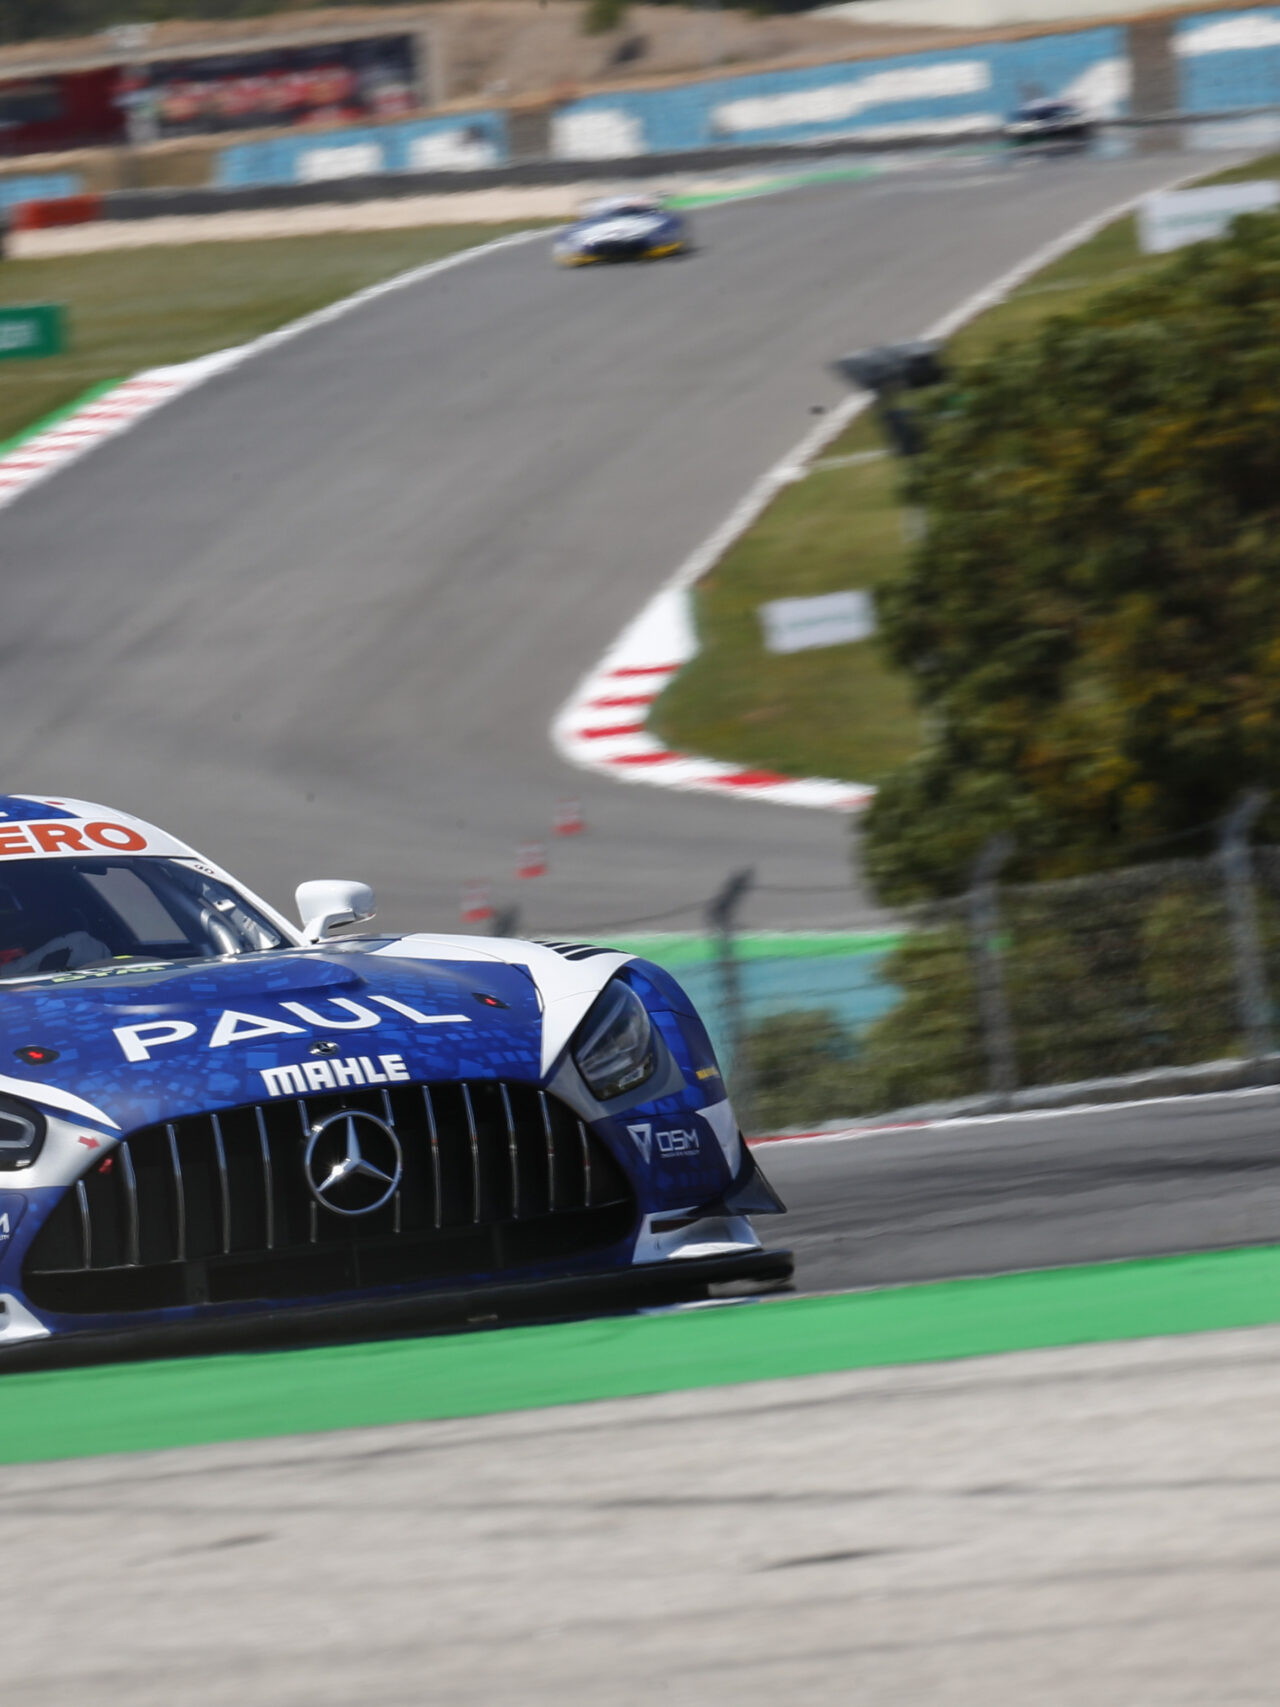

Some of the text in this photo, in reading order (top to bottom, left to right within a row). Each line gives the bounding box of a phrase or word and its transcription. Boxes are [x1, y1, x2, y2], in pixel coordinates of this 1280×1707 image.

[112, 995, 472, 1062] PAUL
[260, 1054, 411, 1096] MAHLE
[656, 1128, 699, 1152] OSM
